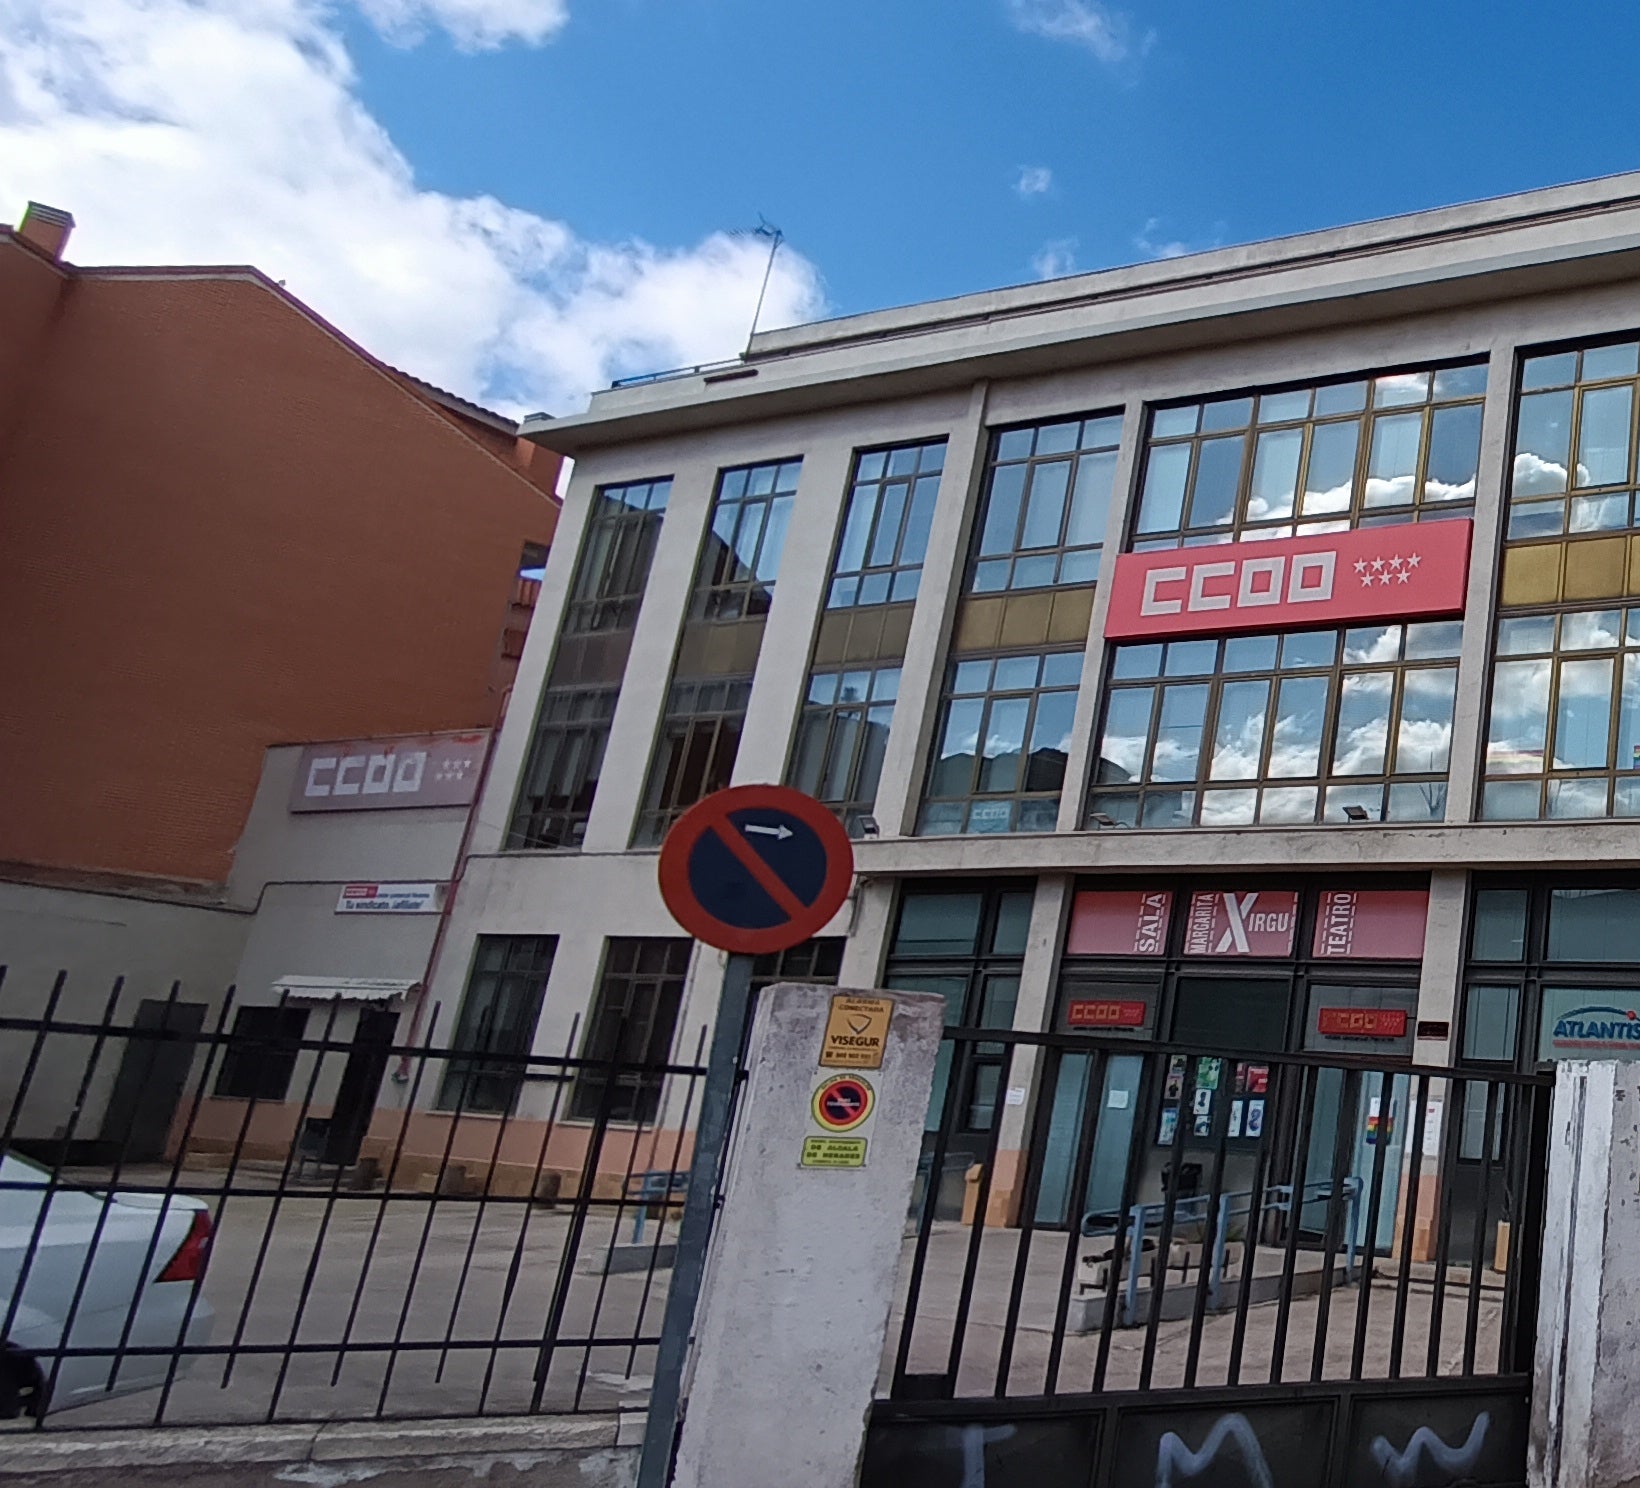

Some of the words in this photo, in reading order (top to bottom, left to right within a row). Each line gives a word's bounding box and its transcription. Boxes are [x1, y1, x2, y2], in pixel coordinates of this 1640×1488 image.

[1140, 551, 1337, 617] CCOO
[304, 752, 427, 796] CCOO
[1138, 893, 1164, 952] SALA
[1189, 893, 1214, 954] MARGARITA
[1326, 893, 1352, 955] TEATRO
[831, 1034, 880, 1048] VISEGUR
[1071, 1004, 1121, 1020] CCOO
